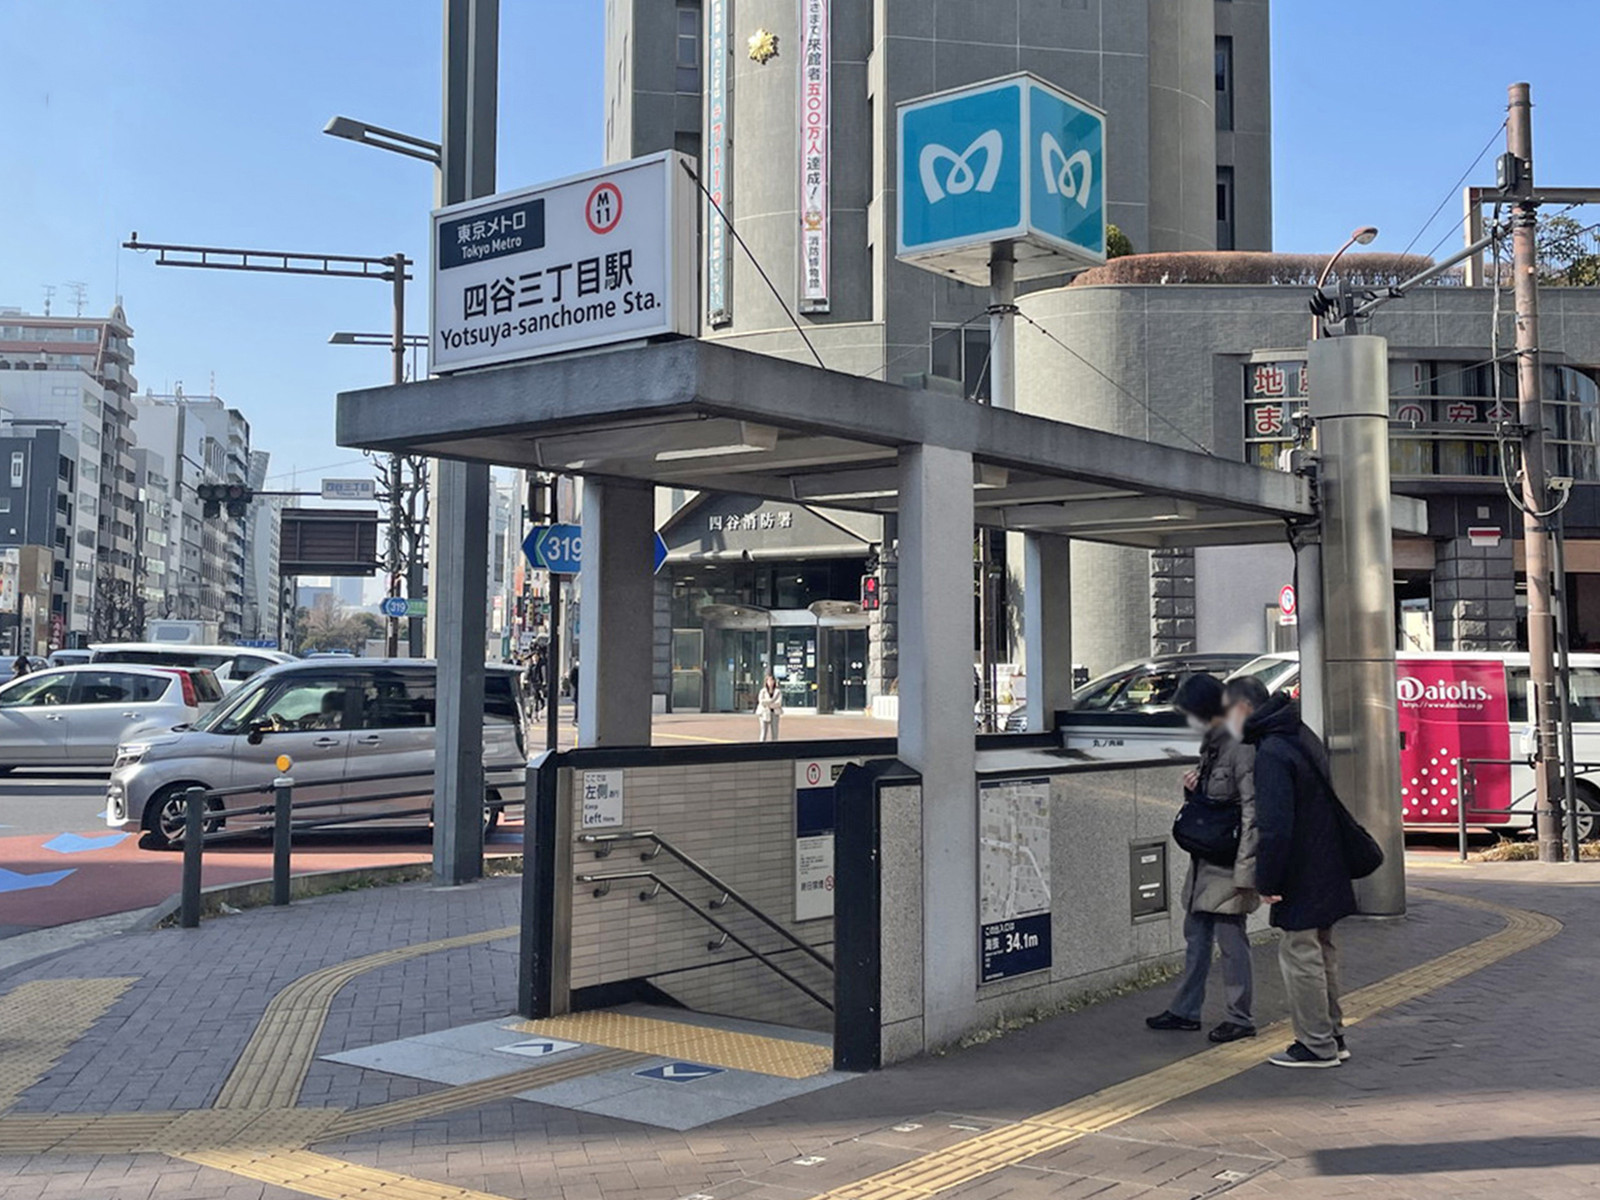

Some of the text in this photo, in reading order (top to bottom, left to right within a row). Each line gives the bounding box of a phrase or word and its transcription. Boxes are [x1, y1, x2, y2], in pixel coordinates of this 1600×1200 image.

[597, 192, 609, 207] M
[596, 207, 610, 224] 11
[457, 211, 526, 244] 東京メトロ
[461, 235, 522, 260] Tokyo Metro
[463, 249, 633, 320] 四谷三丁目駅
[440, 290, 661, 350] Yotsuya-sanchome Sta.
[709, 512, 793, 531] 四谷消防署
[547, 536, 583, 562] 319
[584, 812, 602, 824] Left
[1005, 932, 1039, 953] 34.1m
